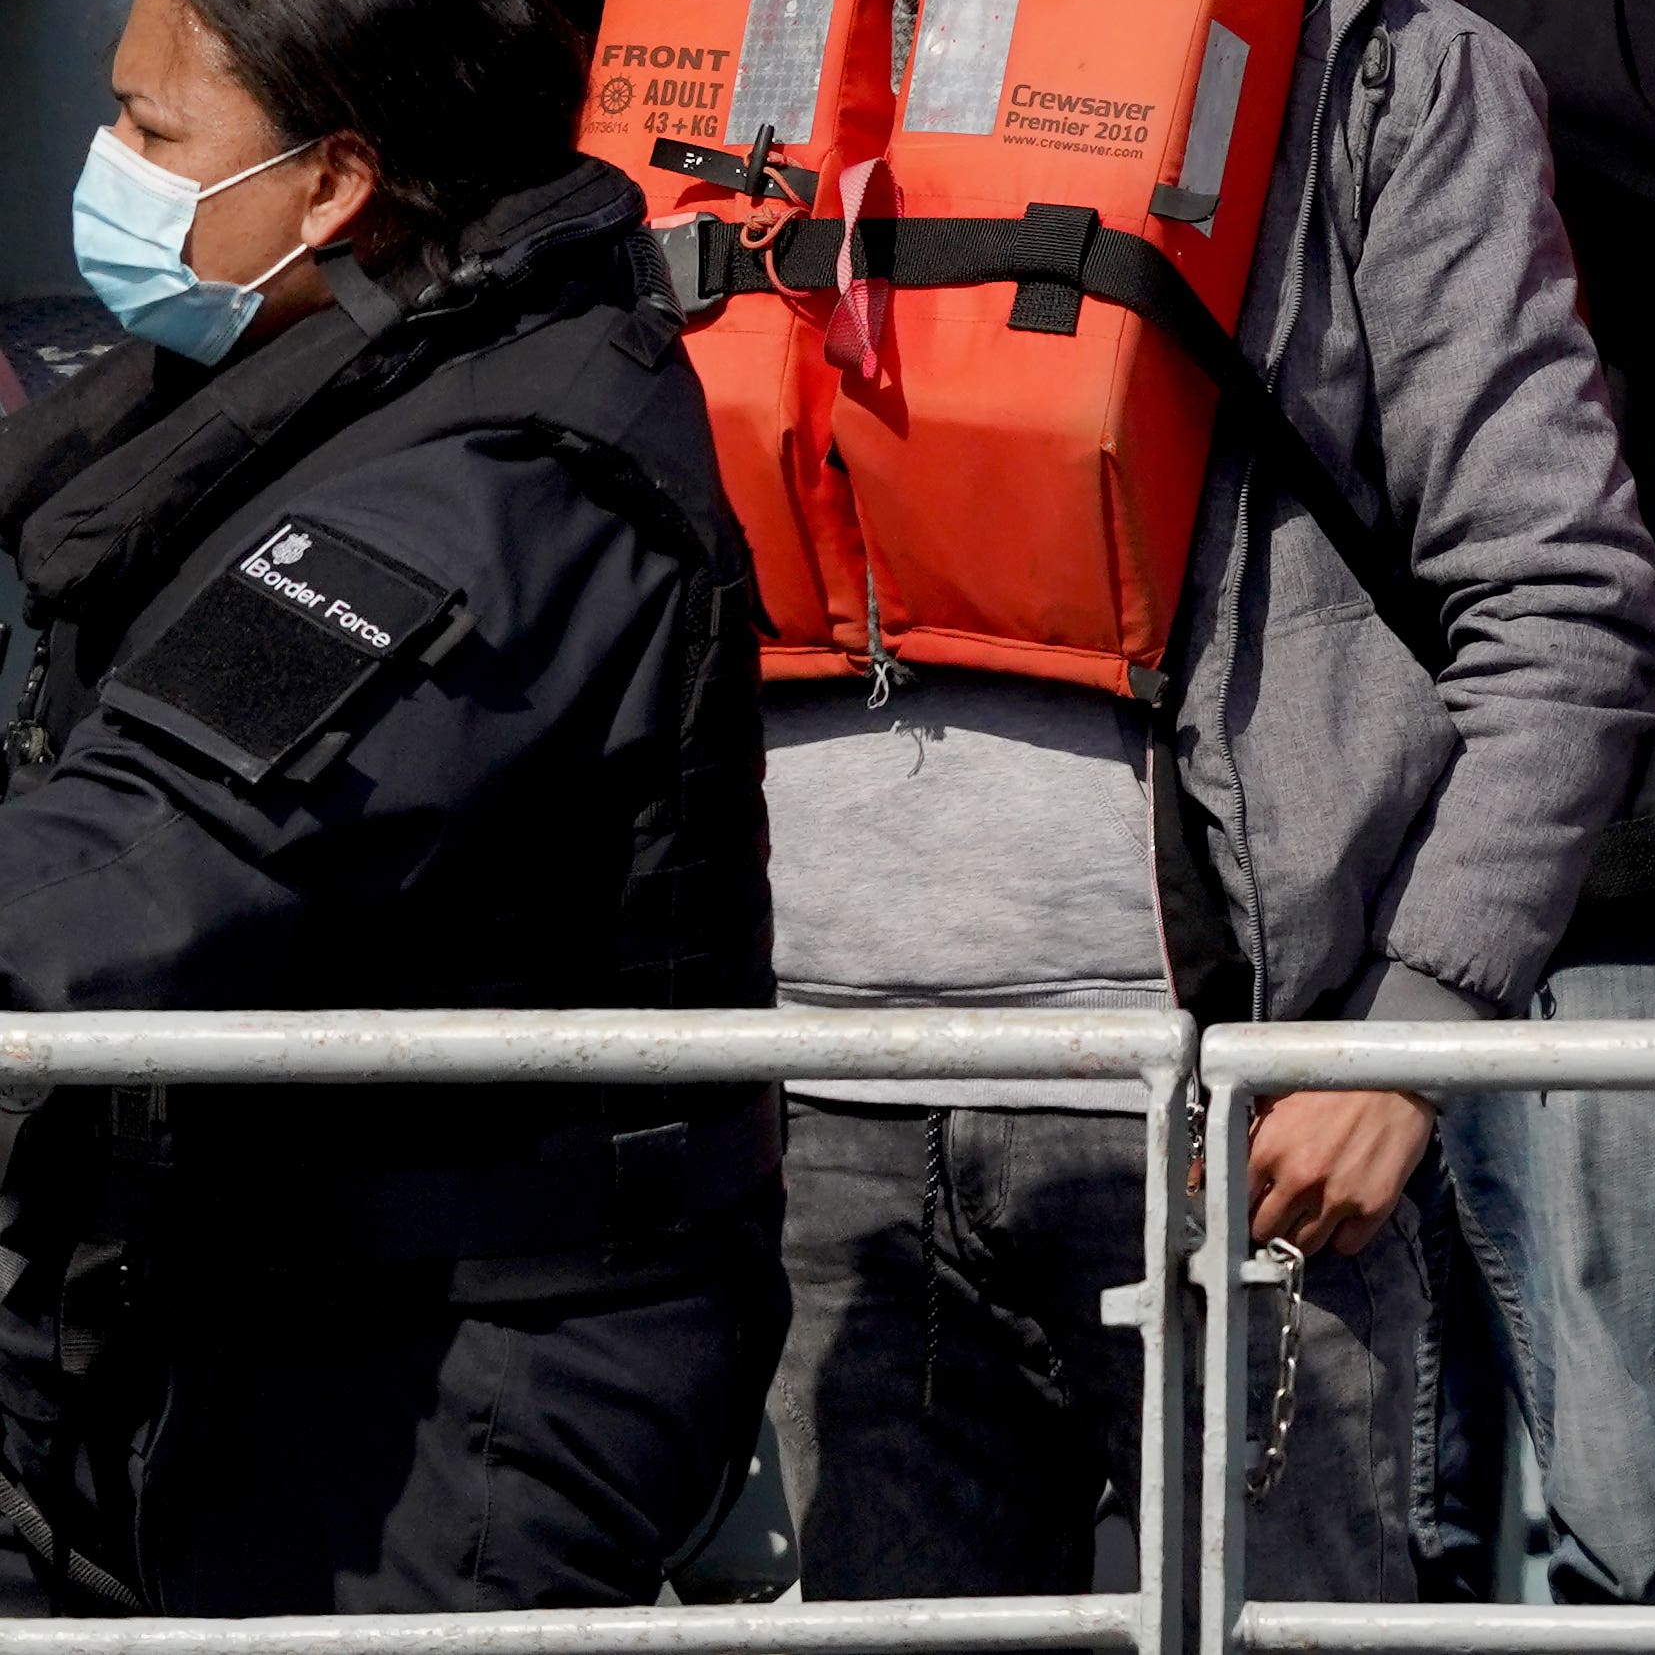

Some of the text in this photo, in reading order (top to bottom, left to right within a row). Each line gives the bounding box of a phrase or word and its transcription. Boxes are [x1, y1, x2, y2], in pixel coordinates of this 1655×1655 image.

[601, 45, 731, 72] FRONT
[642, 78, 725, 110] ADULT
[1010, 84, 1156, 122] Crewsaver
[1005, 111, 1149, 143] Premier 2010
[1003, 134, 1144, 160] www.crewsaver.com
[245, 557, 392, 649] Border Force
